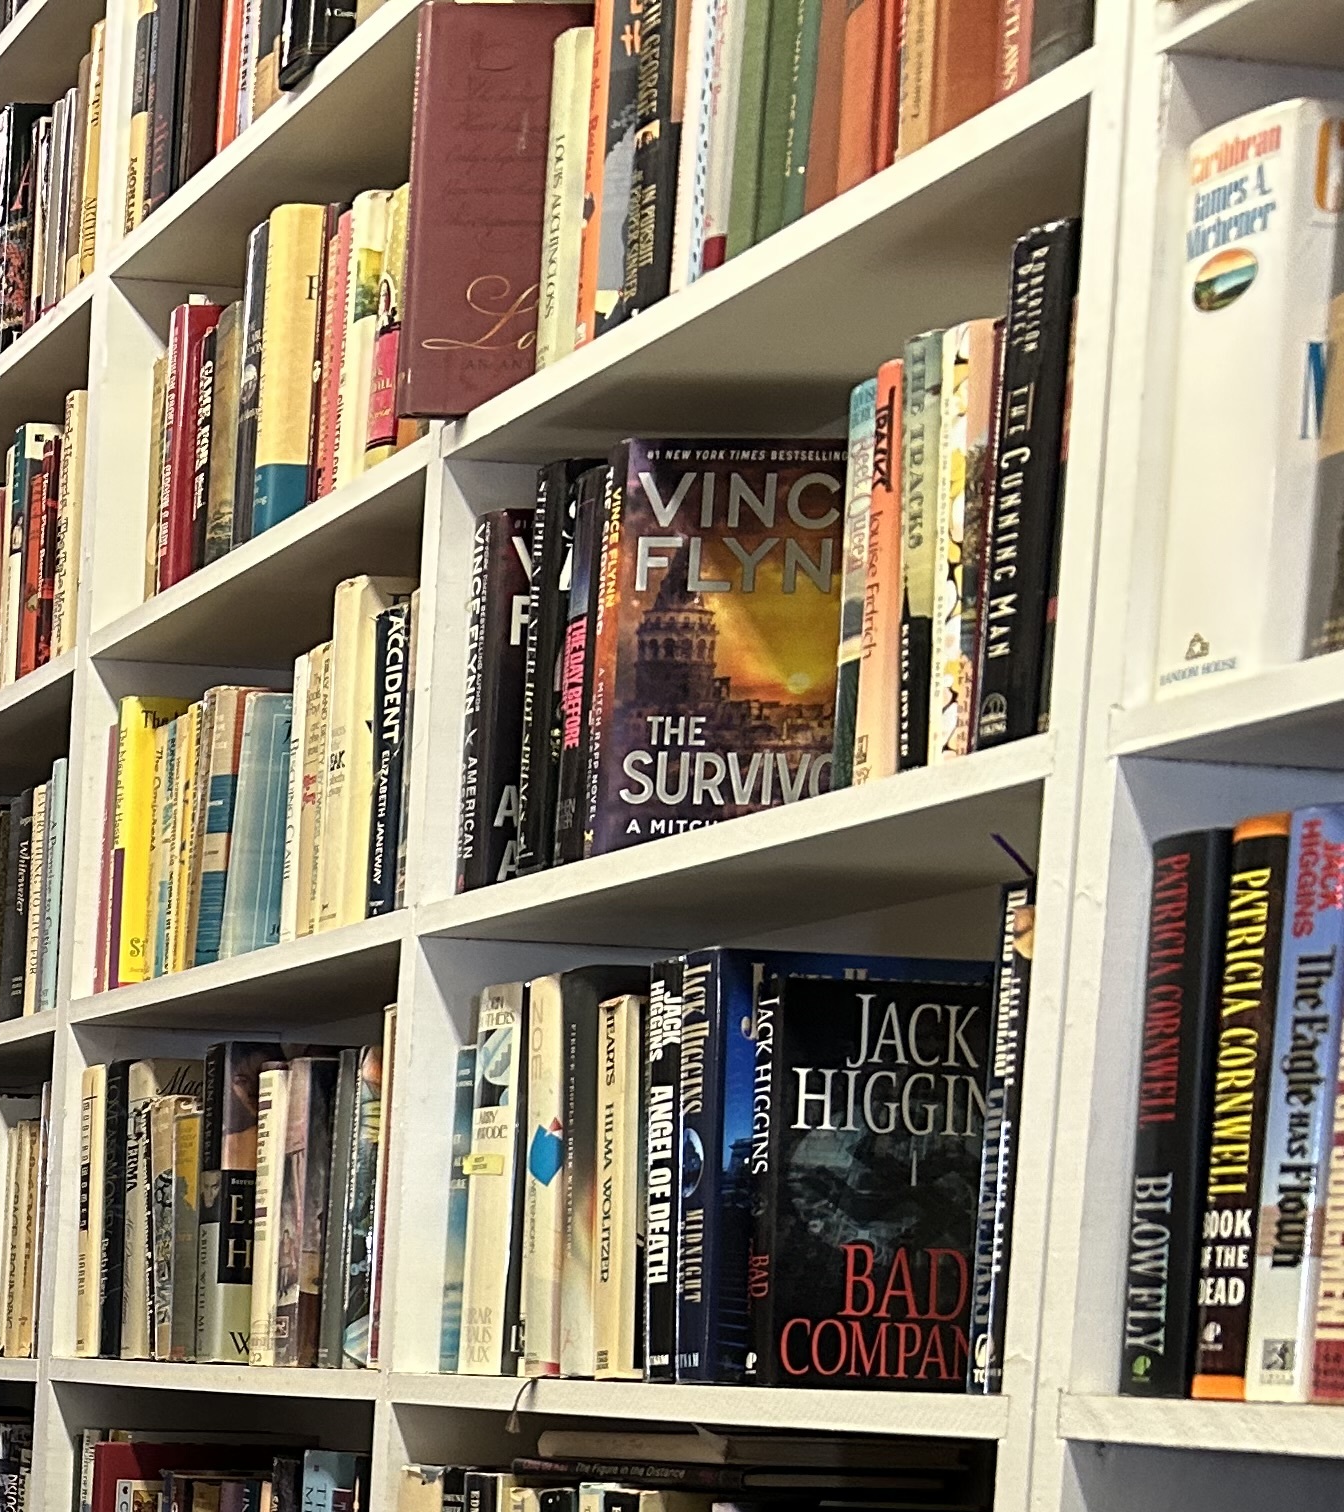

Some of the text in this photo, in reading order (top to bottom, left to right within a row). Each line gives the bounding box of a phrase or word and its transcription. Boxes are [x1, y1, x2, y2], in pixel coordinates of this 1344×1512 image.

[639, 205, 655, 267] PURSUIT
[729, 451, 767, 462] TIMES
[637, 471, 842, 529] VINC
[634, 536, 837, 594] FLYN
[987, 446, 1031, 659] CUNNING MAN
[371, 615, 406, 886] ACCIDENT ELIZABETH JANEWAY
[563, 688, 584, 750] BEFORE
[645, 715, 707, 747] THE
[461, 757, 479, 861] AMERICAN
[618, 748, 833, 804] SURVIVO
[625, 817, 642, 836] A
[13, 839, 30, 917] Whitewater
[1291, 819, 1323, 939] HIGGINS
[649, 979, 665, 1062] HIGGINS
[662, 991, 682, 1045] JACK
[1138, 853, 1192, 1130] PATRICIA CORNWELL
[680, 1021, 710, 1117] HIGGINS
[845, 994, 980, 1068] JACK
[1205, 867, 1272, 1202] PATRICIA CORNWELL
[750, 995, 780, 1175] JACK HIGGINS
[789, 1067, 988, 1137] HIGGIN
[1272, 945, 1337, 1269] The Eagle HAS Flown
[647, 1085, 674, 1285] ANGEL OF DEATH
[683, 1208, 704, 1304] MIDNIGHT
[837, 1241, 968, 1319] BAD
[1123, 1174, 1174, 1355] BLOW FLY
[1214, 1245, 1250, 1271] THE
[780, 1317, 974, 1380] COMPAN
